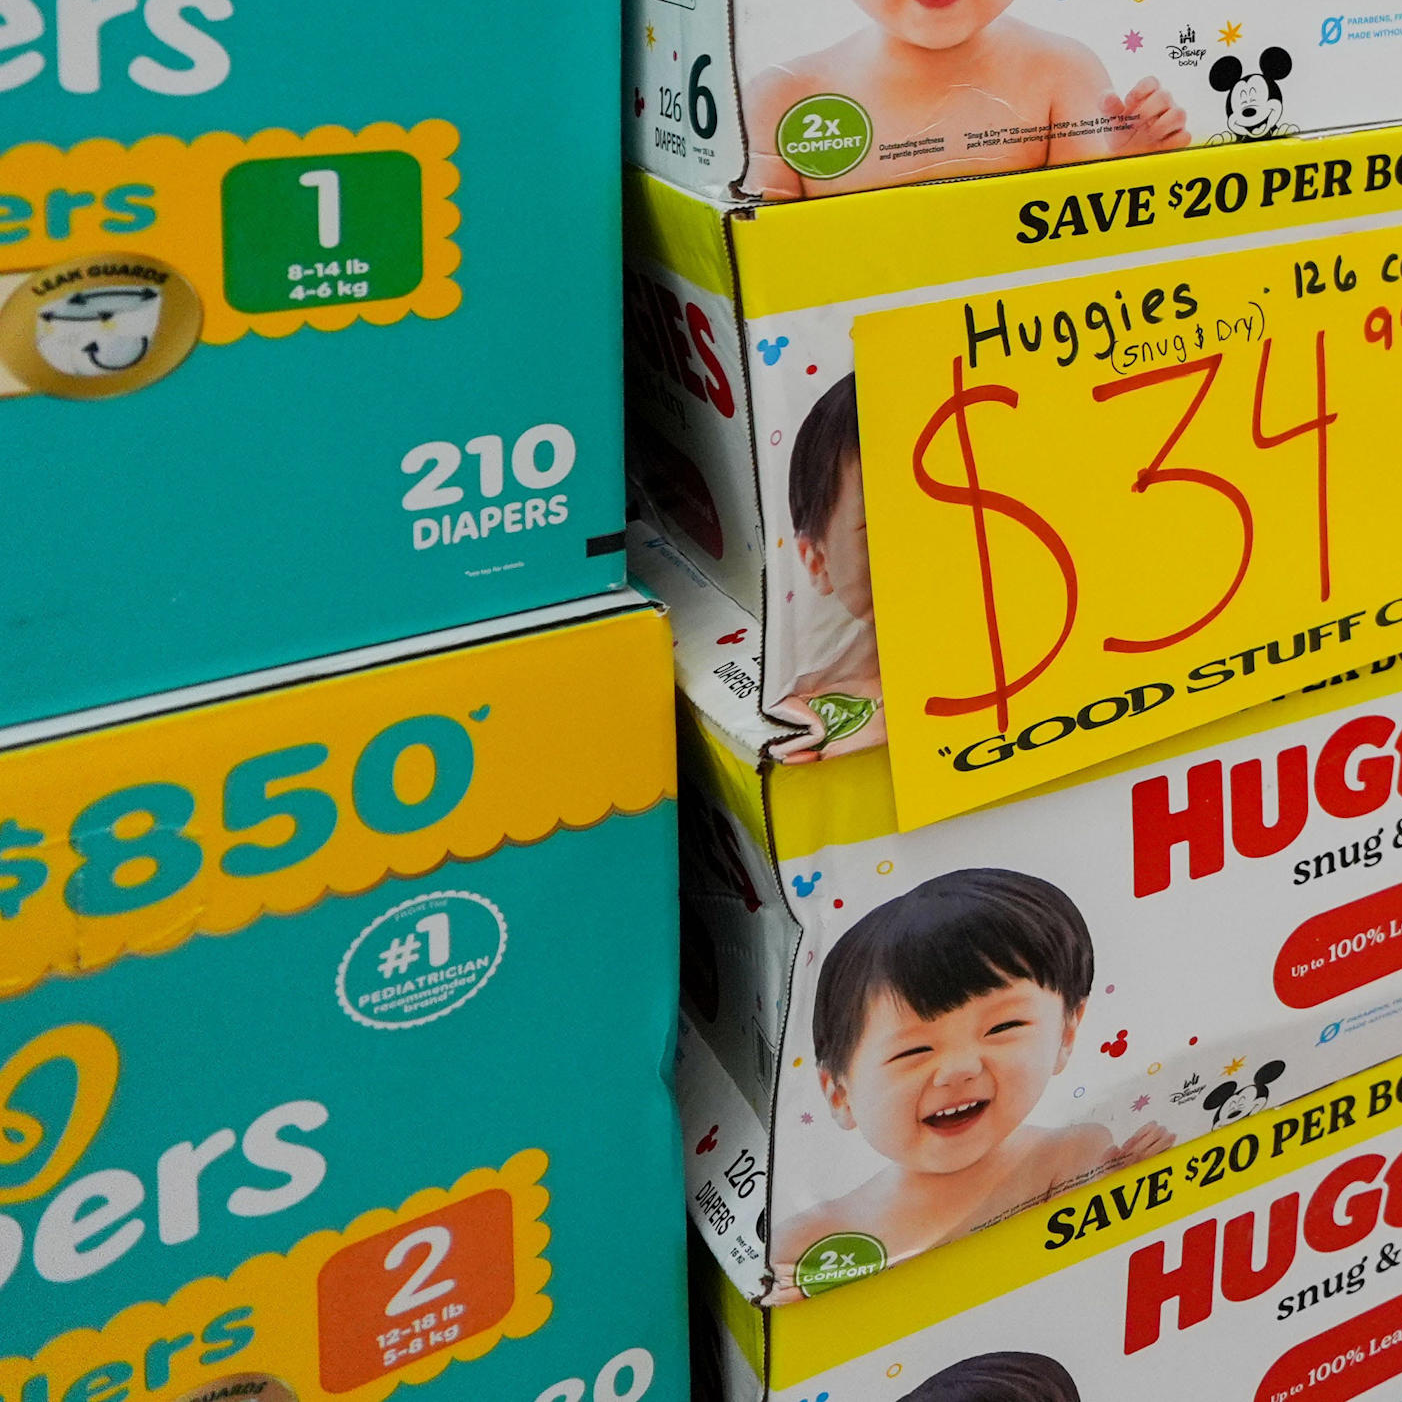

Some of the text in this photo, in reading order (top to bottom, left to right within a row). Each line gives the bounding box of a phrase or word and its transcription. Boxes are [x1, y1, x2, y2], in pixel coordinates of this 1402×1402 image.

[659, 86, 682, 123] 126
[688, 54, 718, 140] 6
[655, 127, 686, 157] DIAPERS
[786, 135, 863, 155] COMFORT
[802, 114, 841, 139] 2x
[299, 170, 341, 250] 1
[1015, 185, 1156, 244] SAVE
[1167, 173, 1249, 222] $20
[1260, 159, 1352, 209] PER
[32, 263, 171, 297] LEAK GUARDS
[287, 258, 370, 282] 8-14 lb
[288, 279, 369, 302] 4-6 kg
[964, 282, 1199, 368] Huggies
[1293, 257, 1358, 300] 126
[400, 423, 577, 512] 210
[413, 494, 569, 551] DIAPERS
[1186, 609, 1367, 697] STUFF
[1292, 830, 1385, 886] snug
[377, 912, 451, 979] #1
[1290, 960, 1310, 978] Up
[1309, 954, 1325, 971] to
[1328, 925, 1386, 964] 100%
[358, 955, 489, 1009] PEDIATRICIAN
[372, 973, 477, 1015] recommended
[1042, 1165, 1174, 1252] SAVE
[1184, 1134, 1260, 1188] $20
[1269, 1104, 1356, 1158] PER
[383, 1225, 456, 1317] 2
[1276, 1254, 1370, 1321] snug
[1375, 1239, 1402, 1274] &
[375, 1303, 465, 1350] 12-18 lb
[383, 1323, 460, 1367] 5-8 kg
